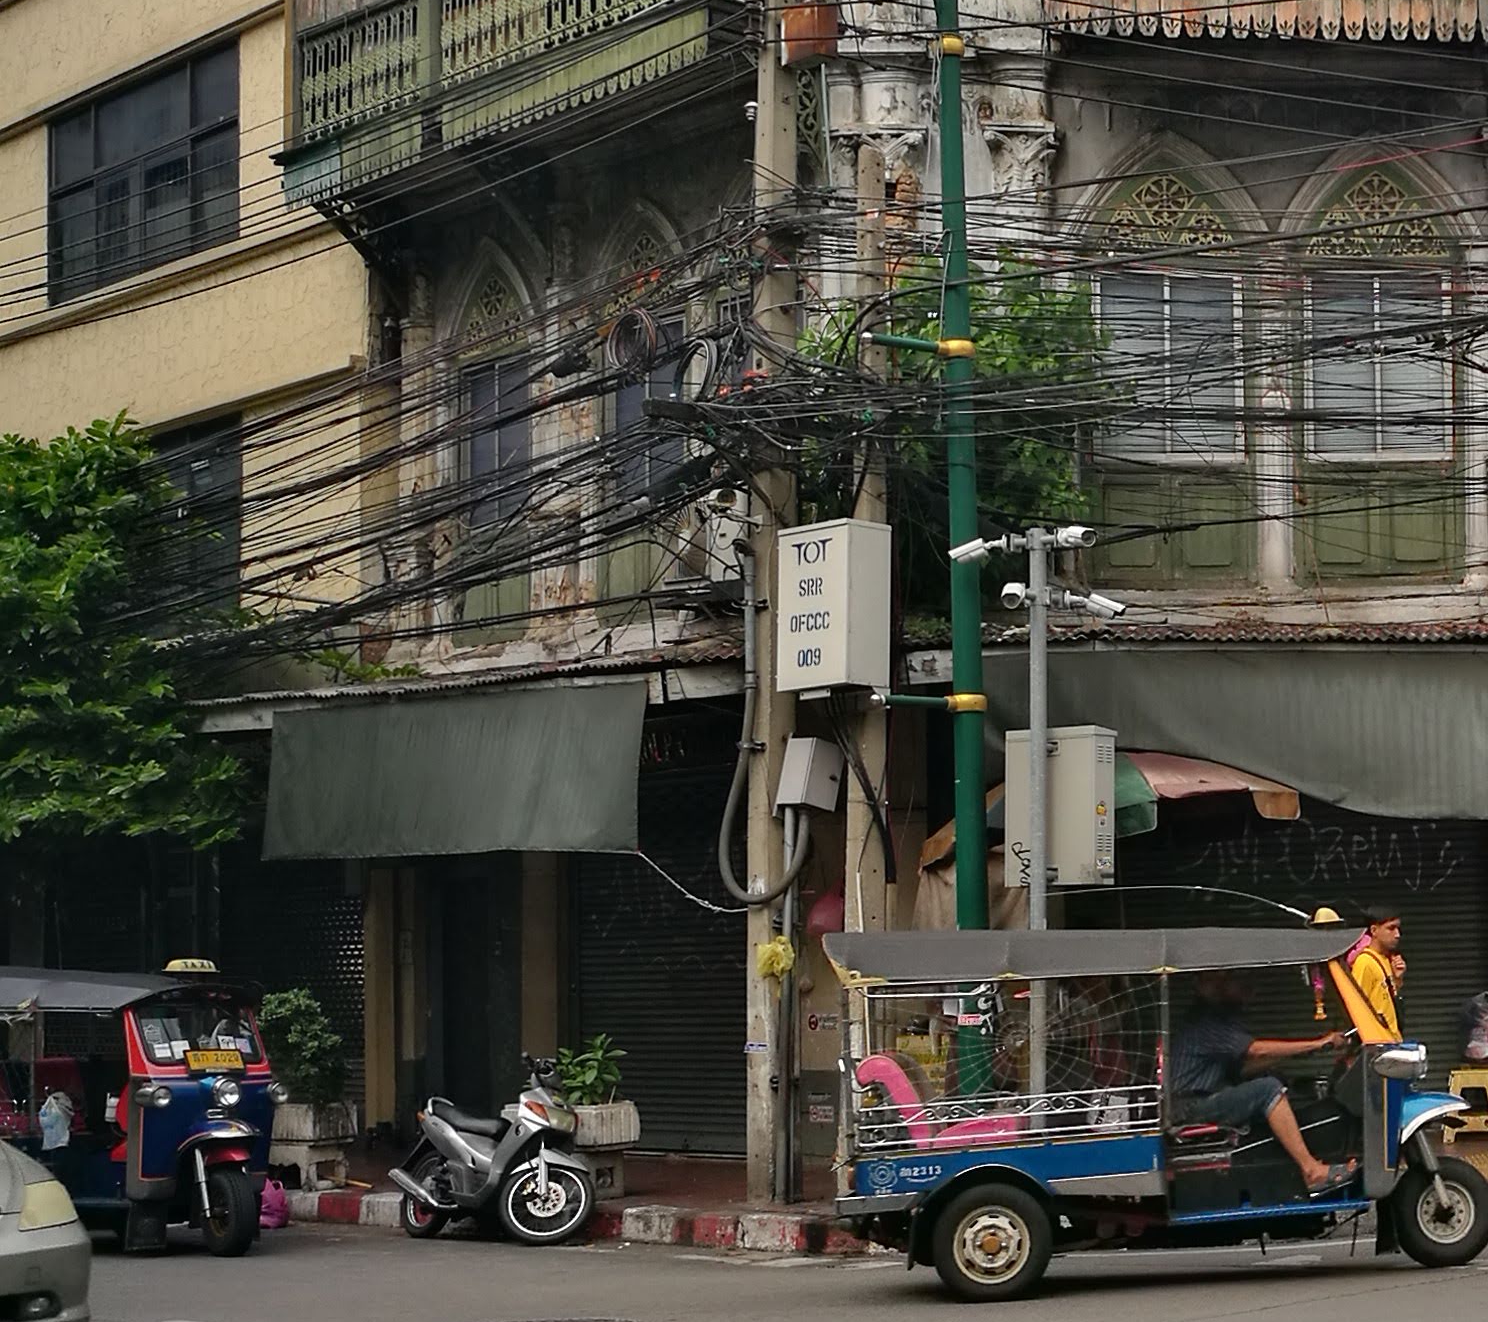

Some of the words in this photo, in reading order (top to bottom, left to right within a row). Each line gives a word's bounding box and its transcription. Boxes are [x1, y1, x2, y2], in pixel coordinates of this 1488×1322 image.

[791, 537, 833, 566] TOT
[798, 576, 824, 598] SRR
[796, 647, 822, 668] 009
[181, 960, 214, 970] TAXI
